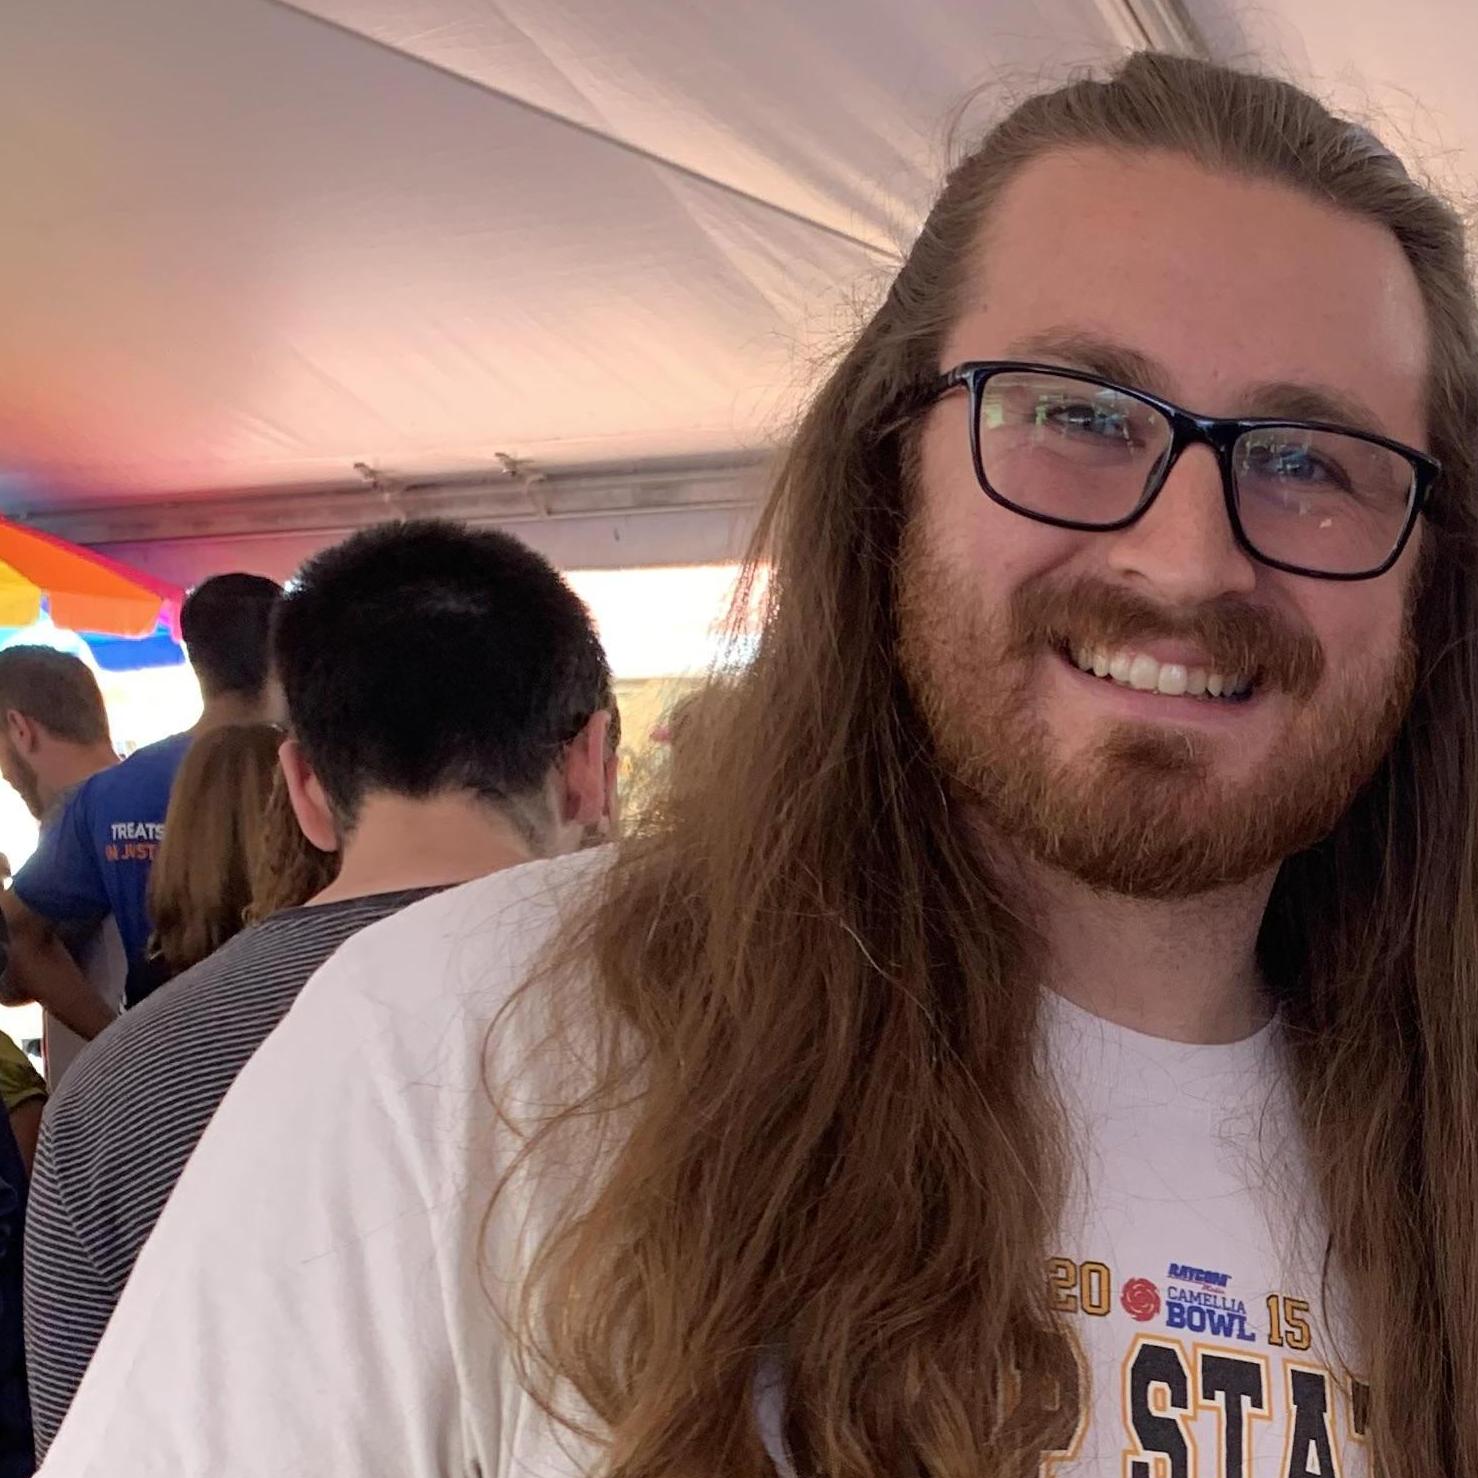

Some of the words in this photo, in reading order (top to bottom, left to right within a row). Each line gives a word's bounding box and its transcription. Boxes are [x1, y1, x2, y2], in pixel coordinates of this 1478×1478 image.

[111, 822, 165, 841] TREATS
[1047, 1257, 1111, 1316] 20
[1167, 1286, 1246, 1315] CAMELLIA
[1166, 1301, 1256, 1342] BOWL
[1266, 1295, 1313, 1350] 15
